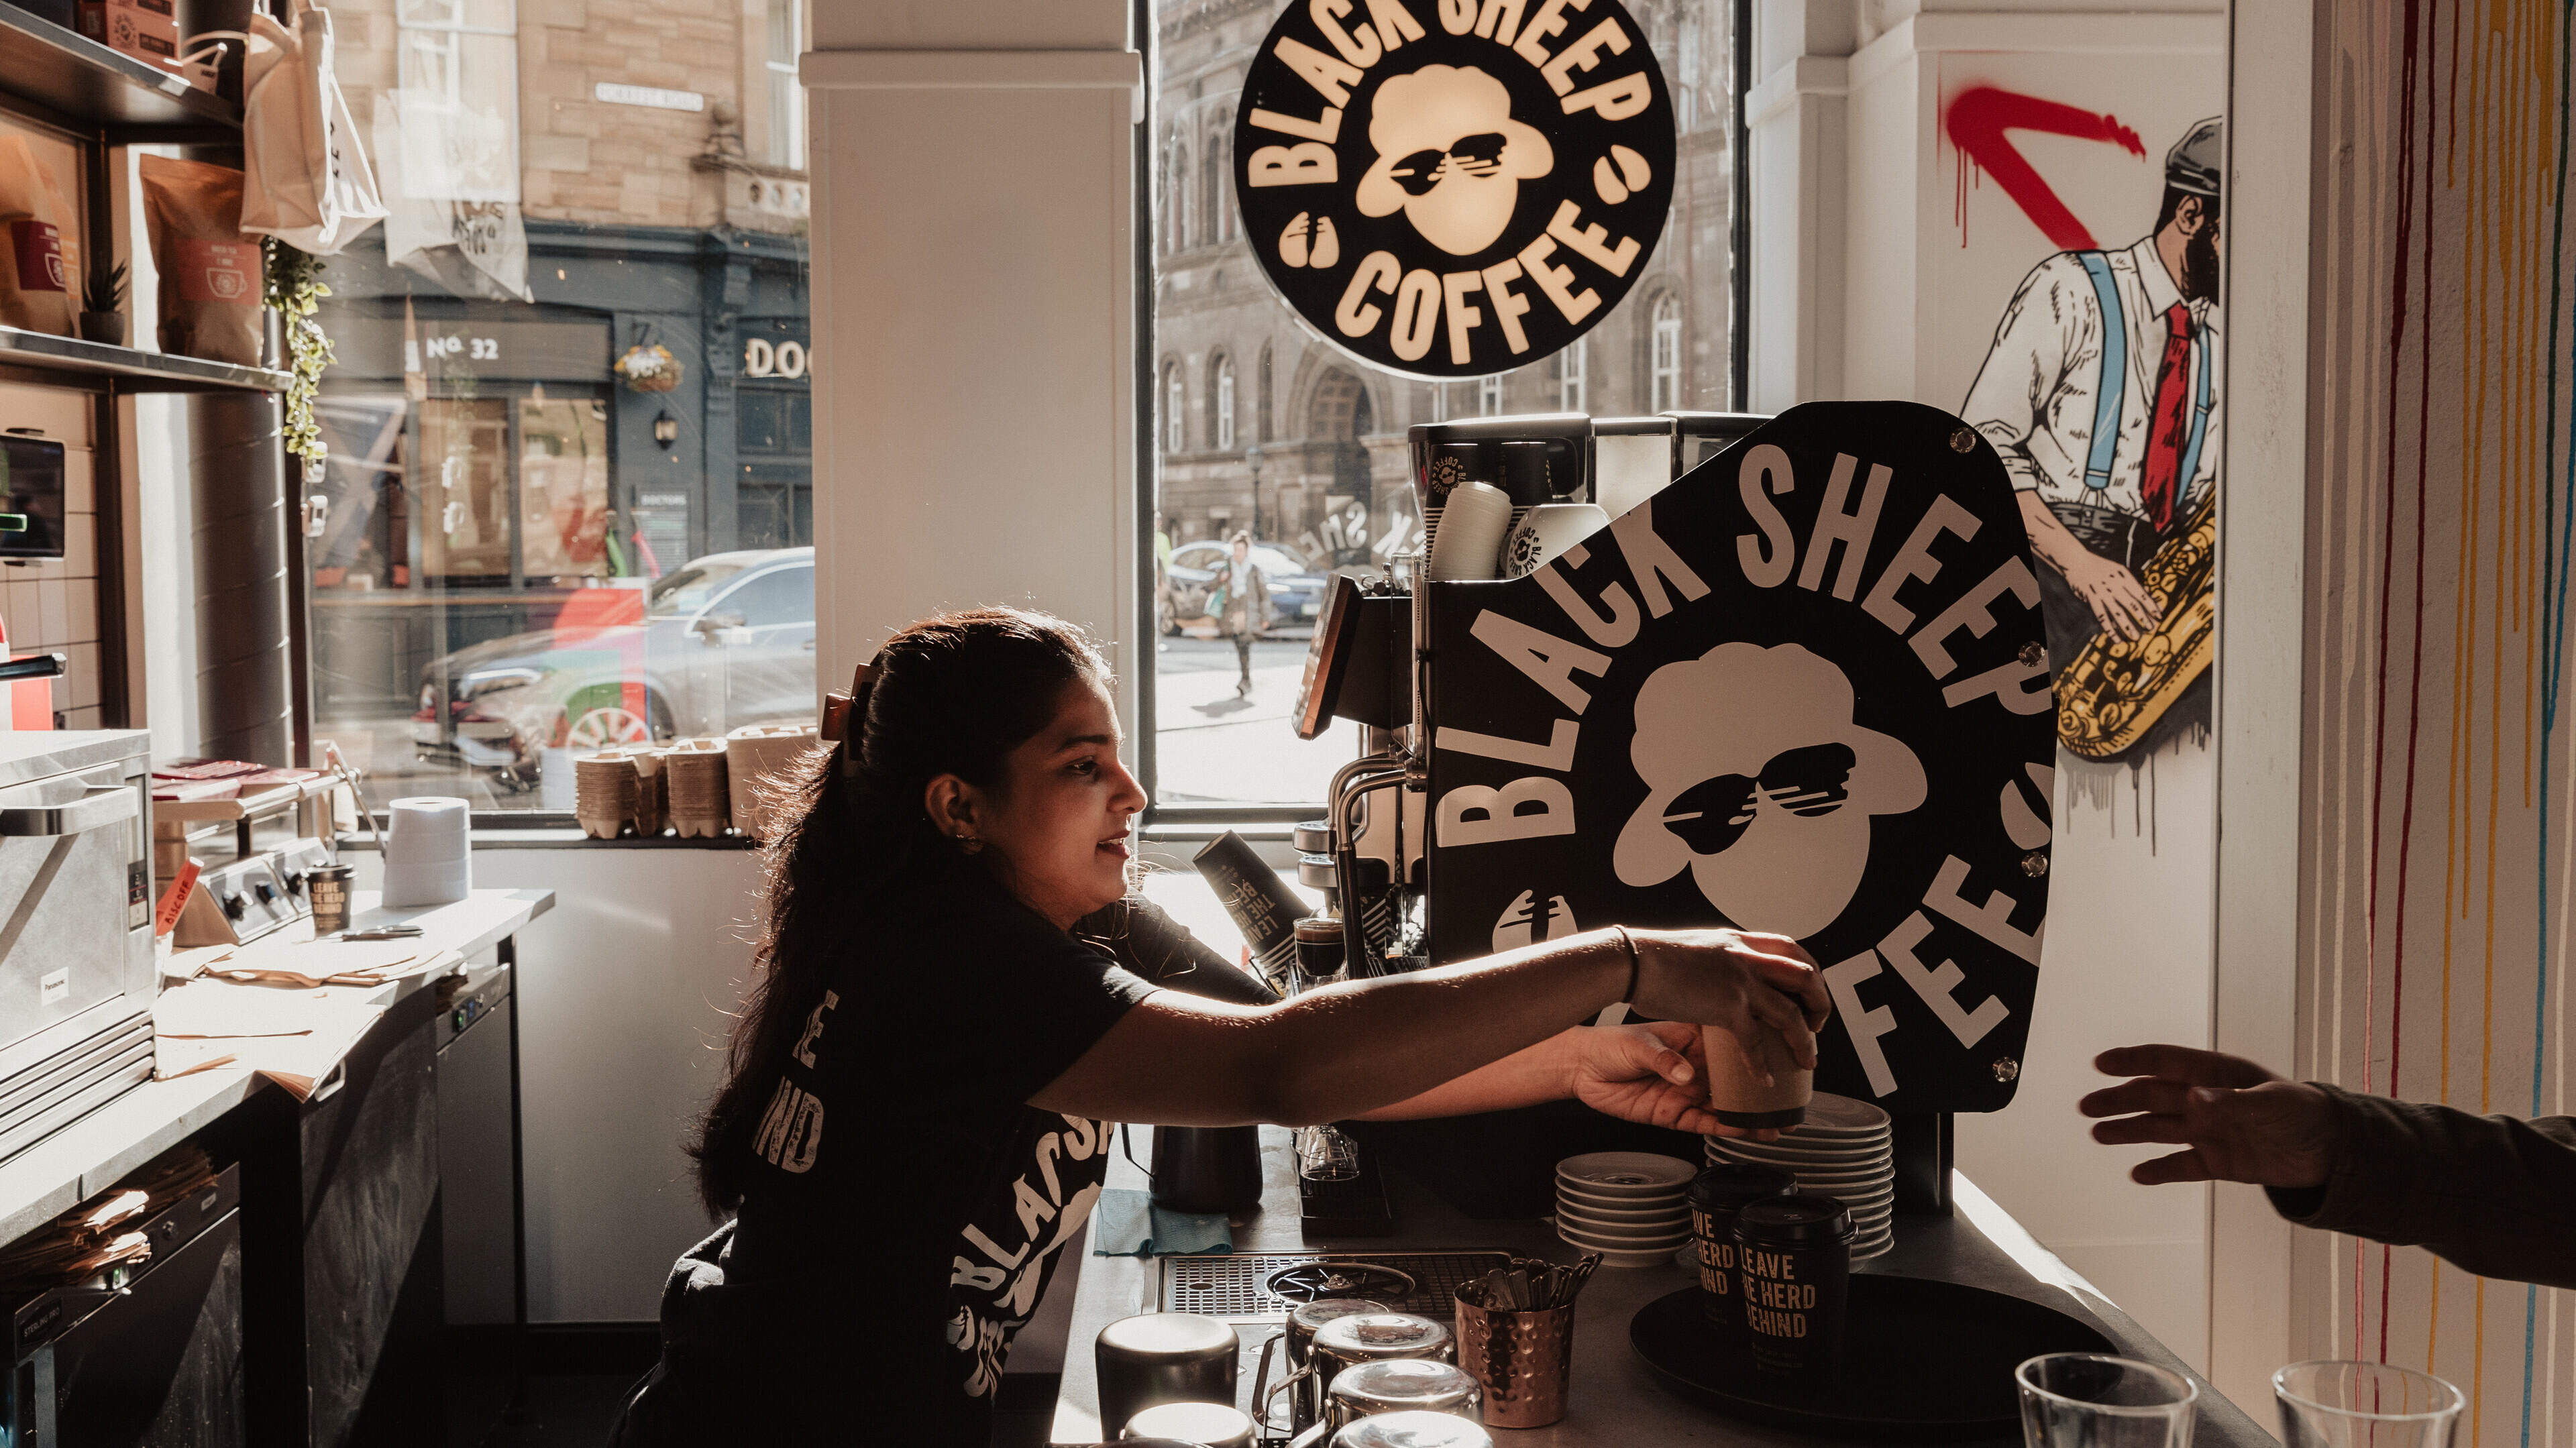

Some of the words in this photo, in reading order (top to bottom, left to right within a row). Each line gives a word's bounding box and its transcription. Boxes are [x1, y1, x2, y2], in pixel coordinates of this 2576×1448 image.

[1248, 0, 1426, 187] BLACK
[1335, 199, 1642, 364] COFFEE
[470, 337, 499, 359] 32
[745, 337, 812, 379] DO
[1436, 498, 1711, 848] BLACK
[1736, 444, 2053, 715] SHEEP
[1246, 893, 1276, 920] THE
[1739, 1243, 1795, 1280] LEAVE
[1760, 1280, 1816, 1309] HERD
